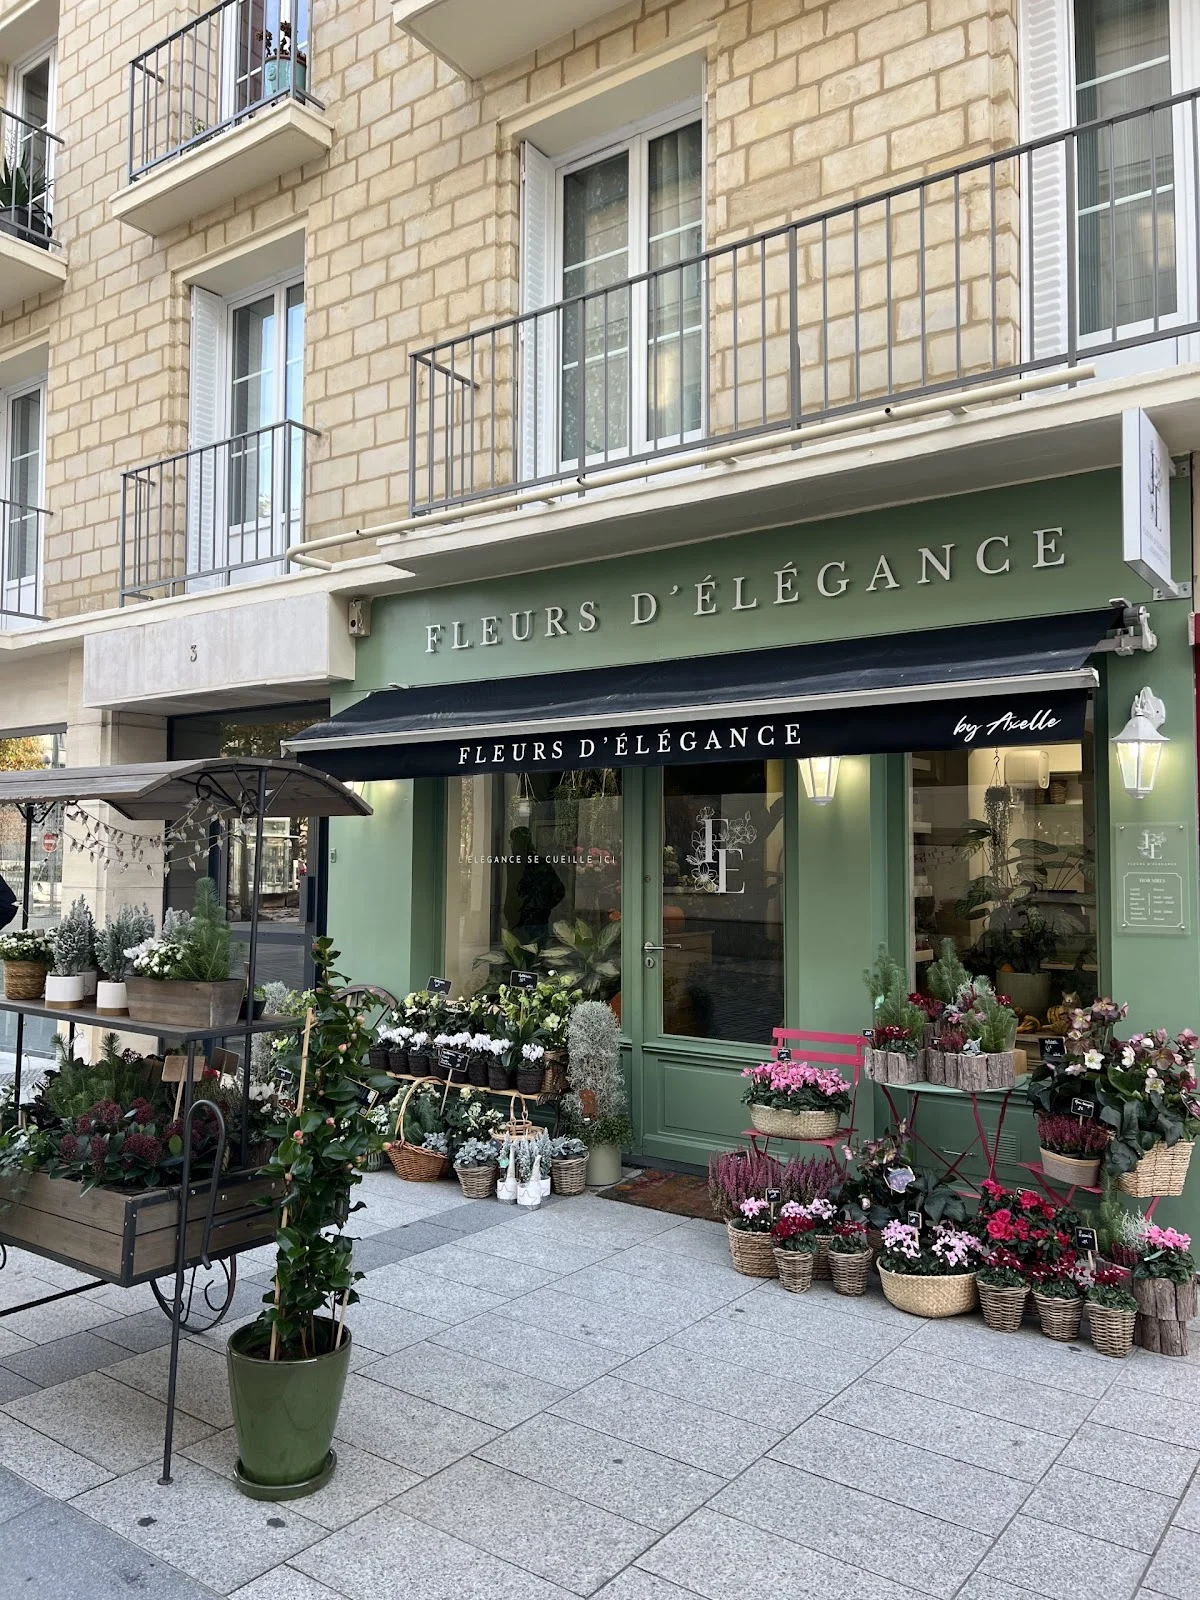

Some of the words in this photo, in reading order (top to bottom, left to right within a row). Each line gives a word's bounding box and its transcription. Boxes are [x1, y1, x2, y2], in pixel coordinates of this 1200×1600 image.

[424, 600, 598, 654] FLEURS
[630, 526, 1066, 625] D'ÉLÉGANCE
[190, 644, 198, 663] 3
[953, 715, 983, 742] by
[986, 709, 1062, 735] Axelle
[458, 739, 564, 765] FLEURS
[579, 722, 803, 758] D'ÉLÉGANCE
[527, 855, 540, 864] SE
[545, 855, 593, 864] CUEILLE
[599, 855, 616, 864] ICI
